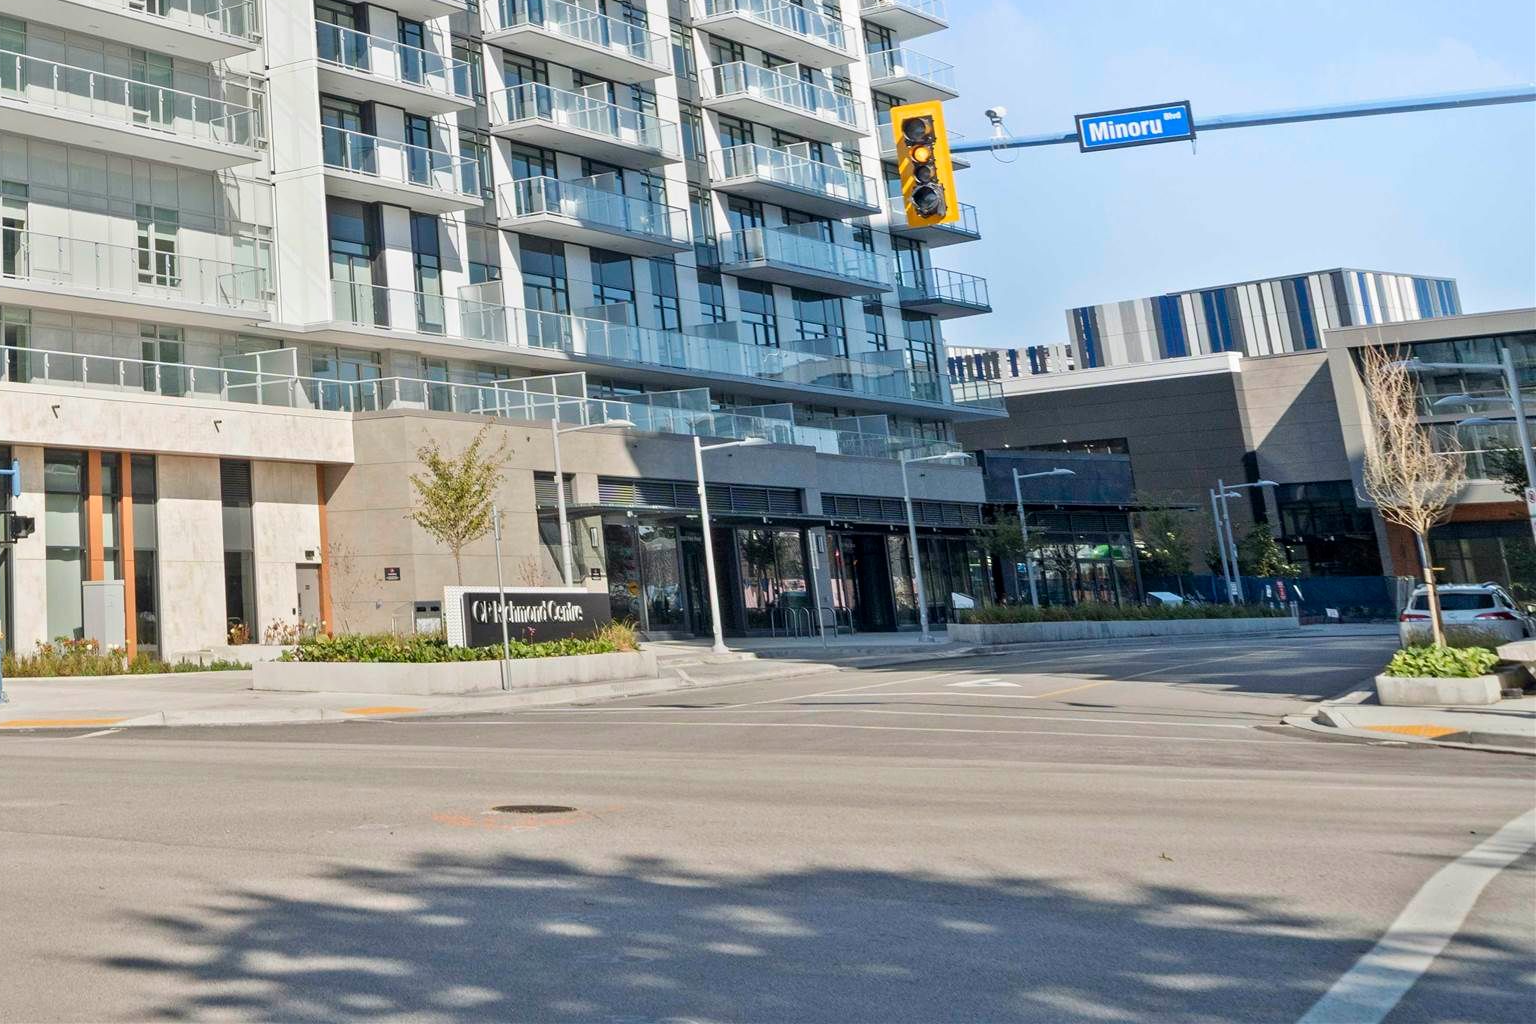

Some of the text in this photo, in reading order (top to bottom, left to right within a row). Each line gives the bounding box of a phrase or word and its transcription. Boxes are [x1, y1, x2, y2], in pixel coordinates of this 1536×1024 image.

[1088, 119, 1163, 142] Minoru
[492, 600, 548, 624] Rchmond
[547, 599, 584, 623] Centre
